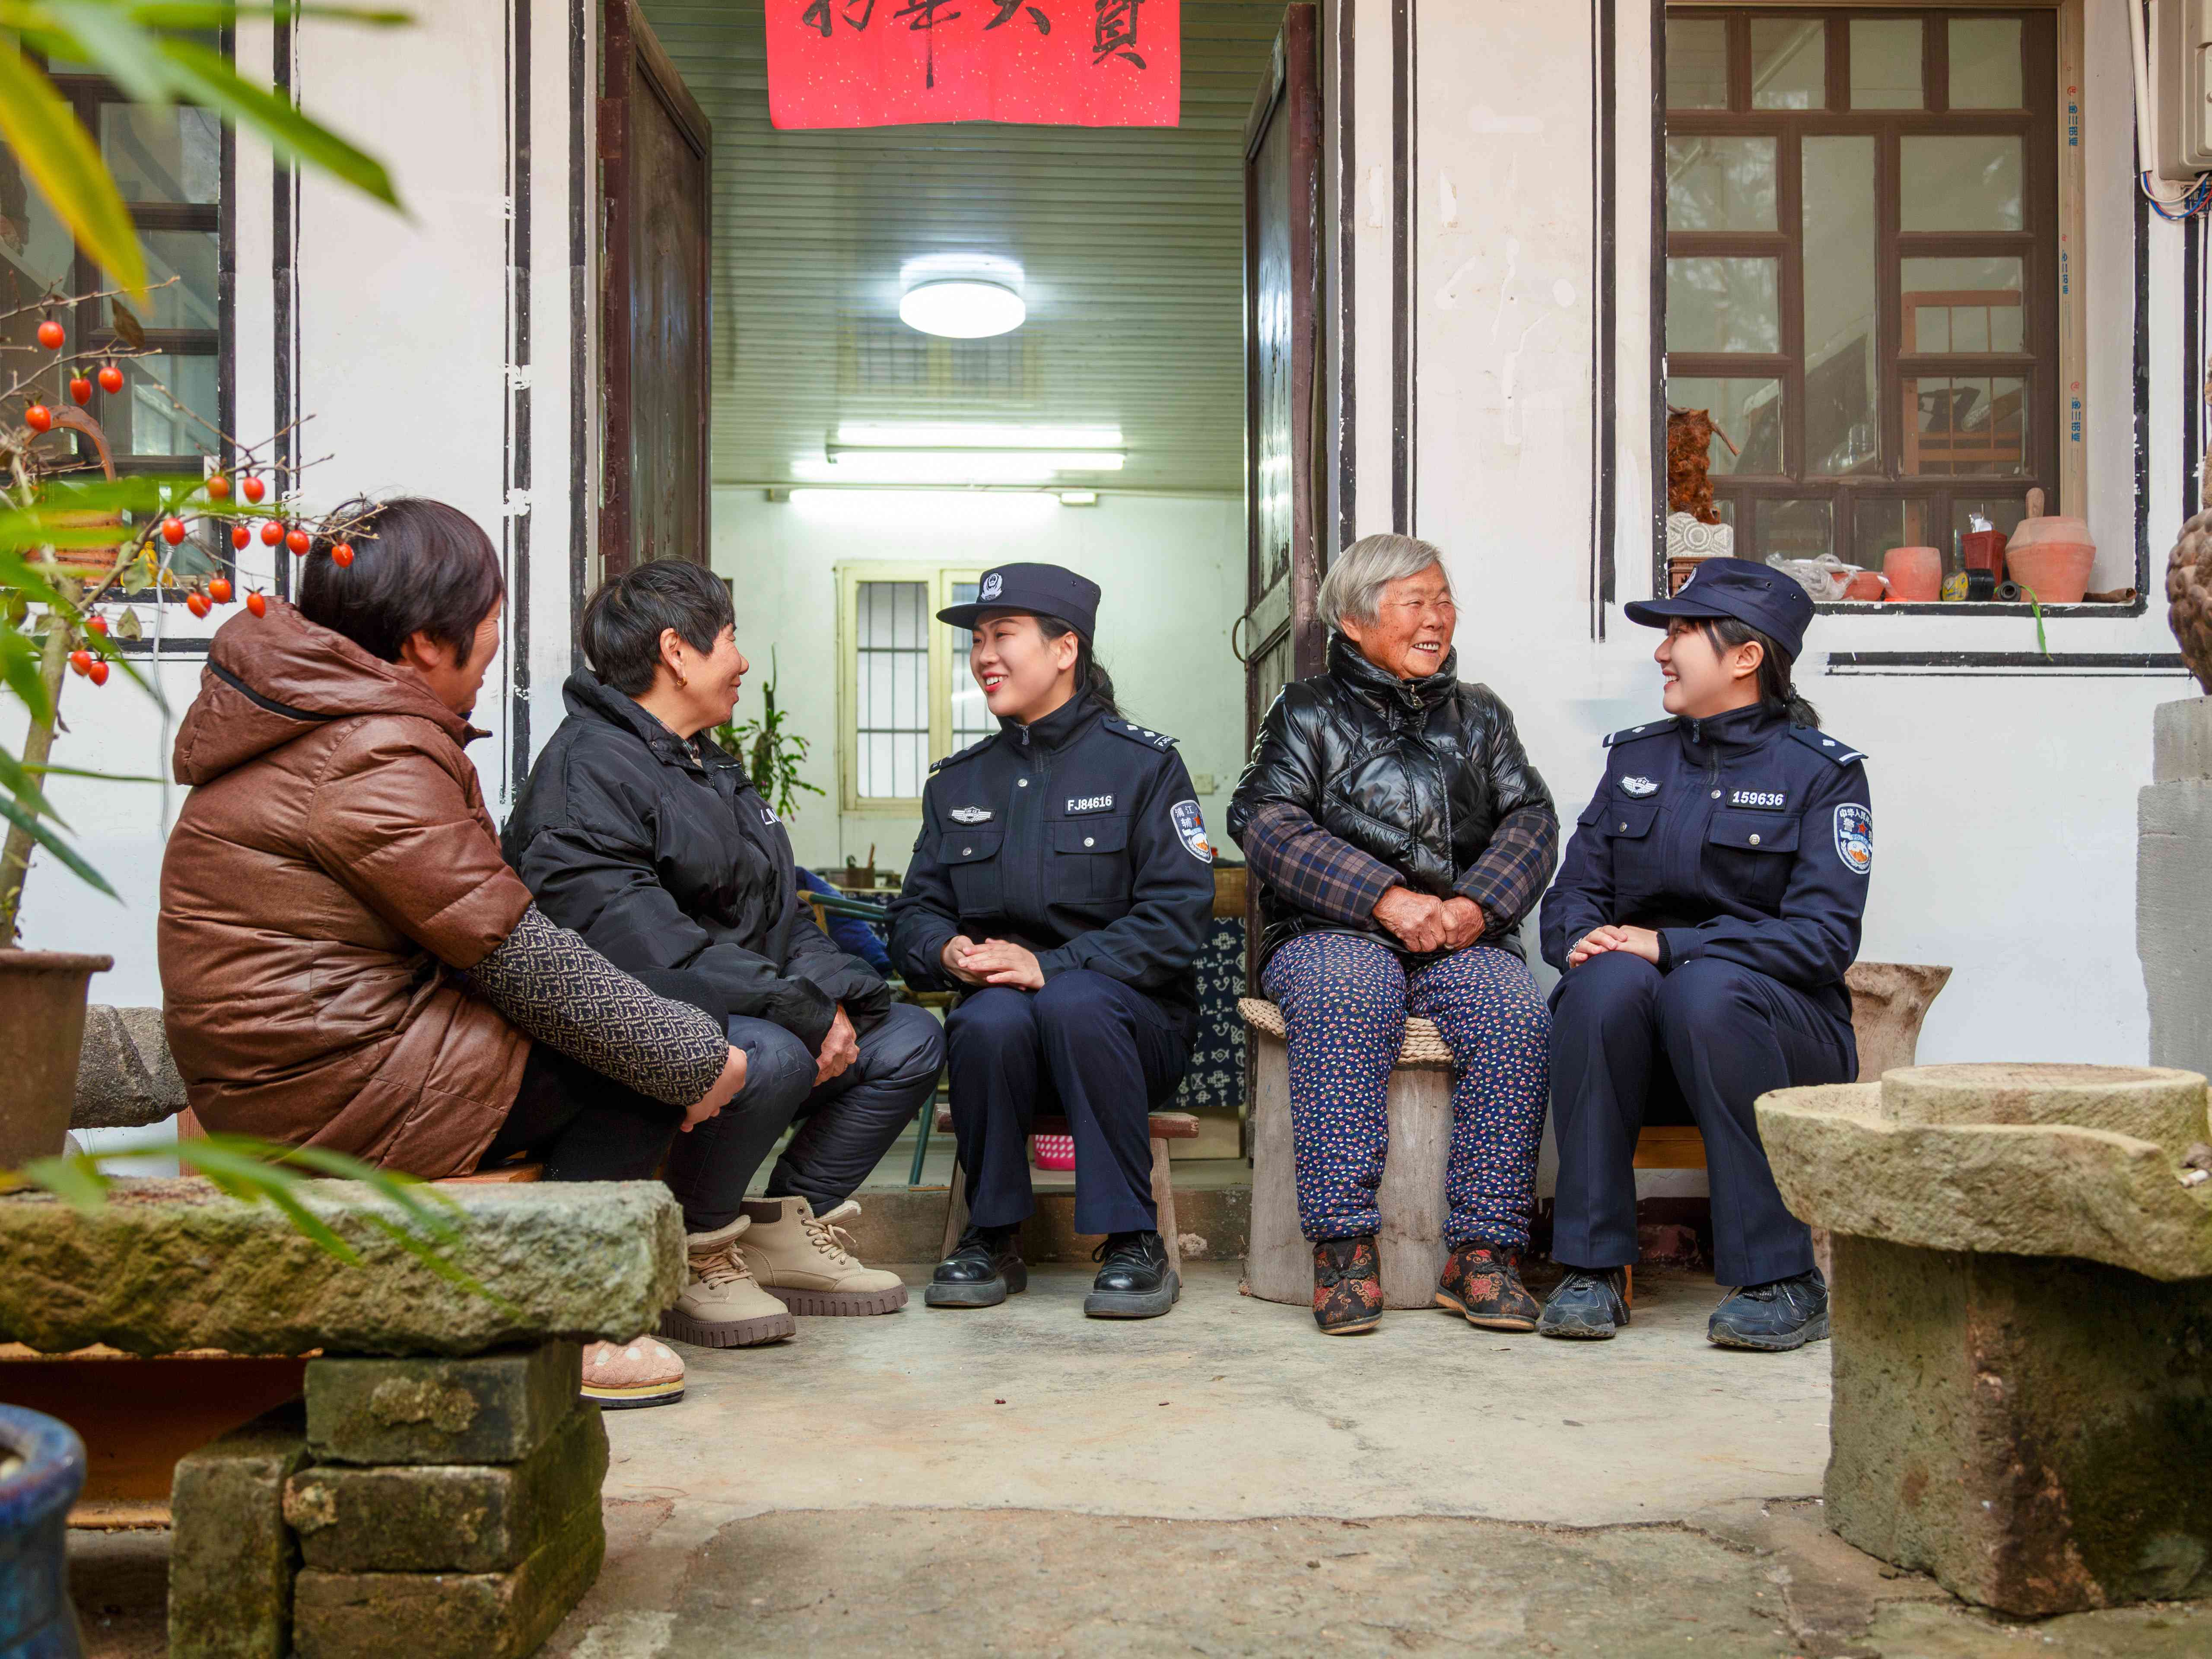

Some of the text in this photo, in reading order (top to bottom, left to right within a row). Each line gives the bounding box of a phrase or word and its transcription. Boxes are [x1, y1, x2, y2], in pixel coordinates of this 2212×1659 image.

[1068, 795, 1112, 811] FJ84616
[1732, 791, 1784, 806] 159636
[1174, 805, 1195, 817] 浦江
